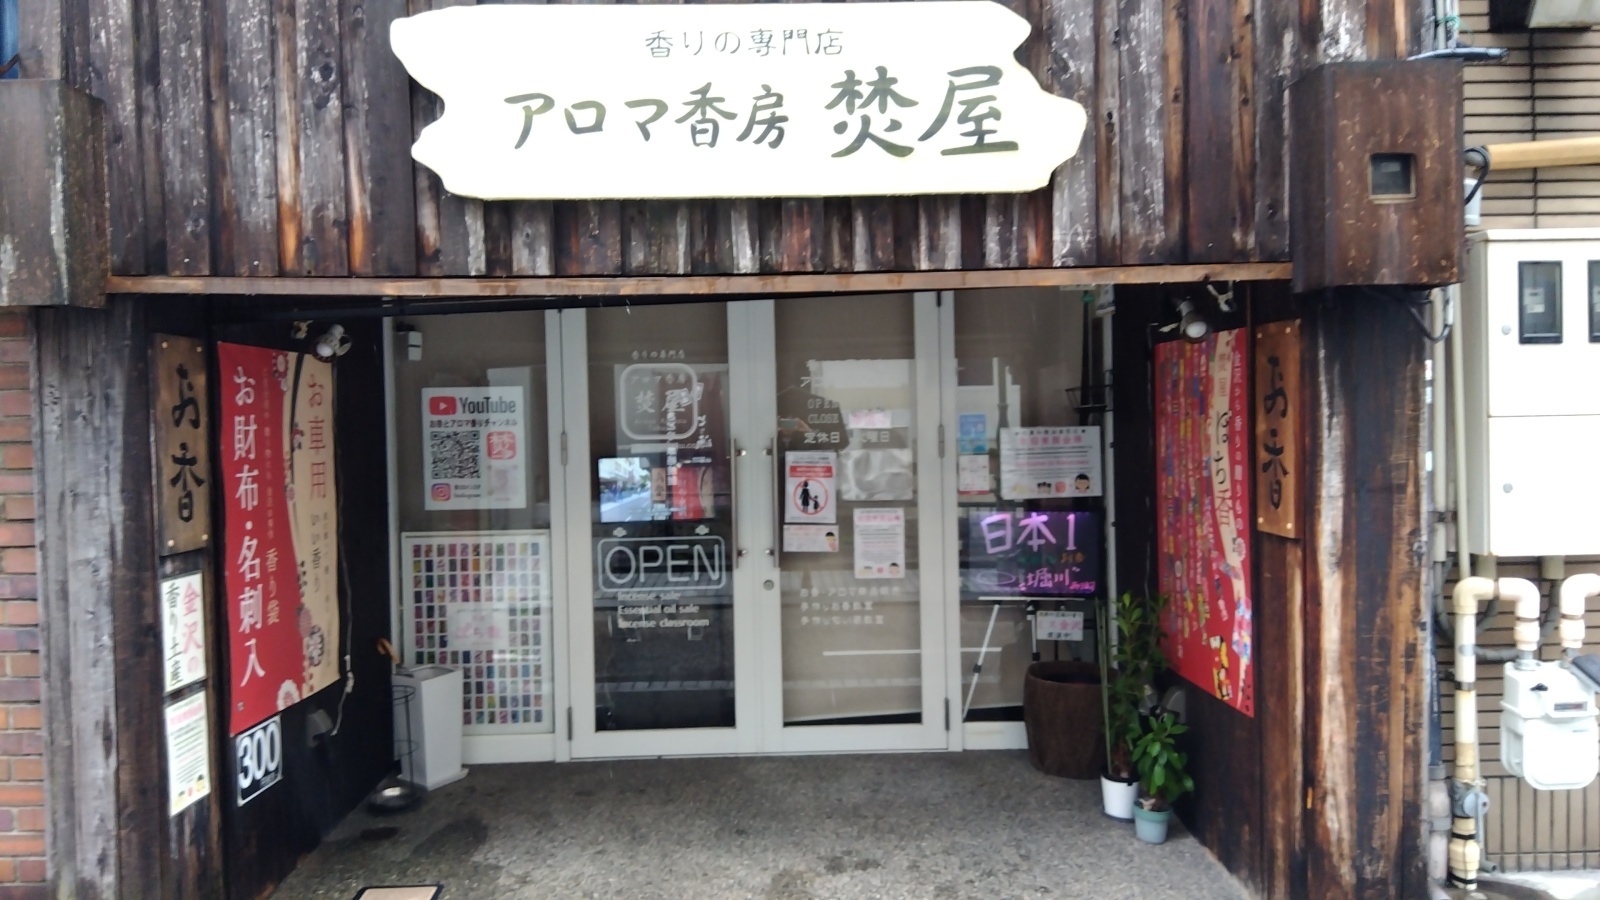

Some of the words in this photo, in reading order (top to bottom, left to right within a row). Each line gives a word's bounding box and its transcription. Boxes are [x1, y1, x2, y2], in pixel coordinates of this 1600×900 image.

[644, 28, 844, 58] 香りの専門店
[503, 81, 788, 149] アロマ香房
[824, 65, 1020, 158] 焚屋
[459, 396, 517, 414] YouTube
[803, 431, 841, 444] 定休日
[1262, 355, 1289, 510] お香
[170, 363, 205, 523] お香
[233, 366, 266, 688] お財布・名刺入
[605, 544, 720, 584] OPEN
[182, 581, 204, 673] 金沢の
[617, 604, 662, 615] Essential
[663, 604, 677, 614] oil
[679, 604, 700, 614] sale
[238, 722, 281, 789] 300
